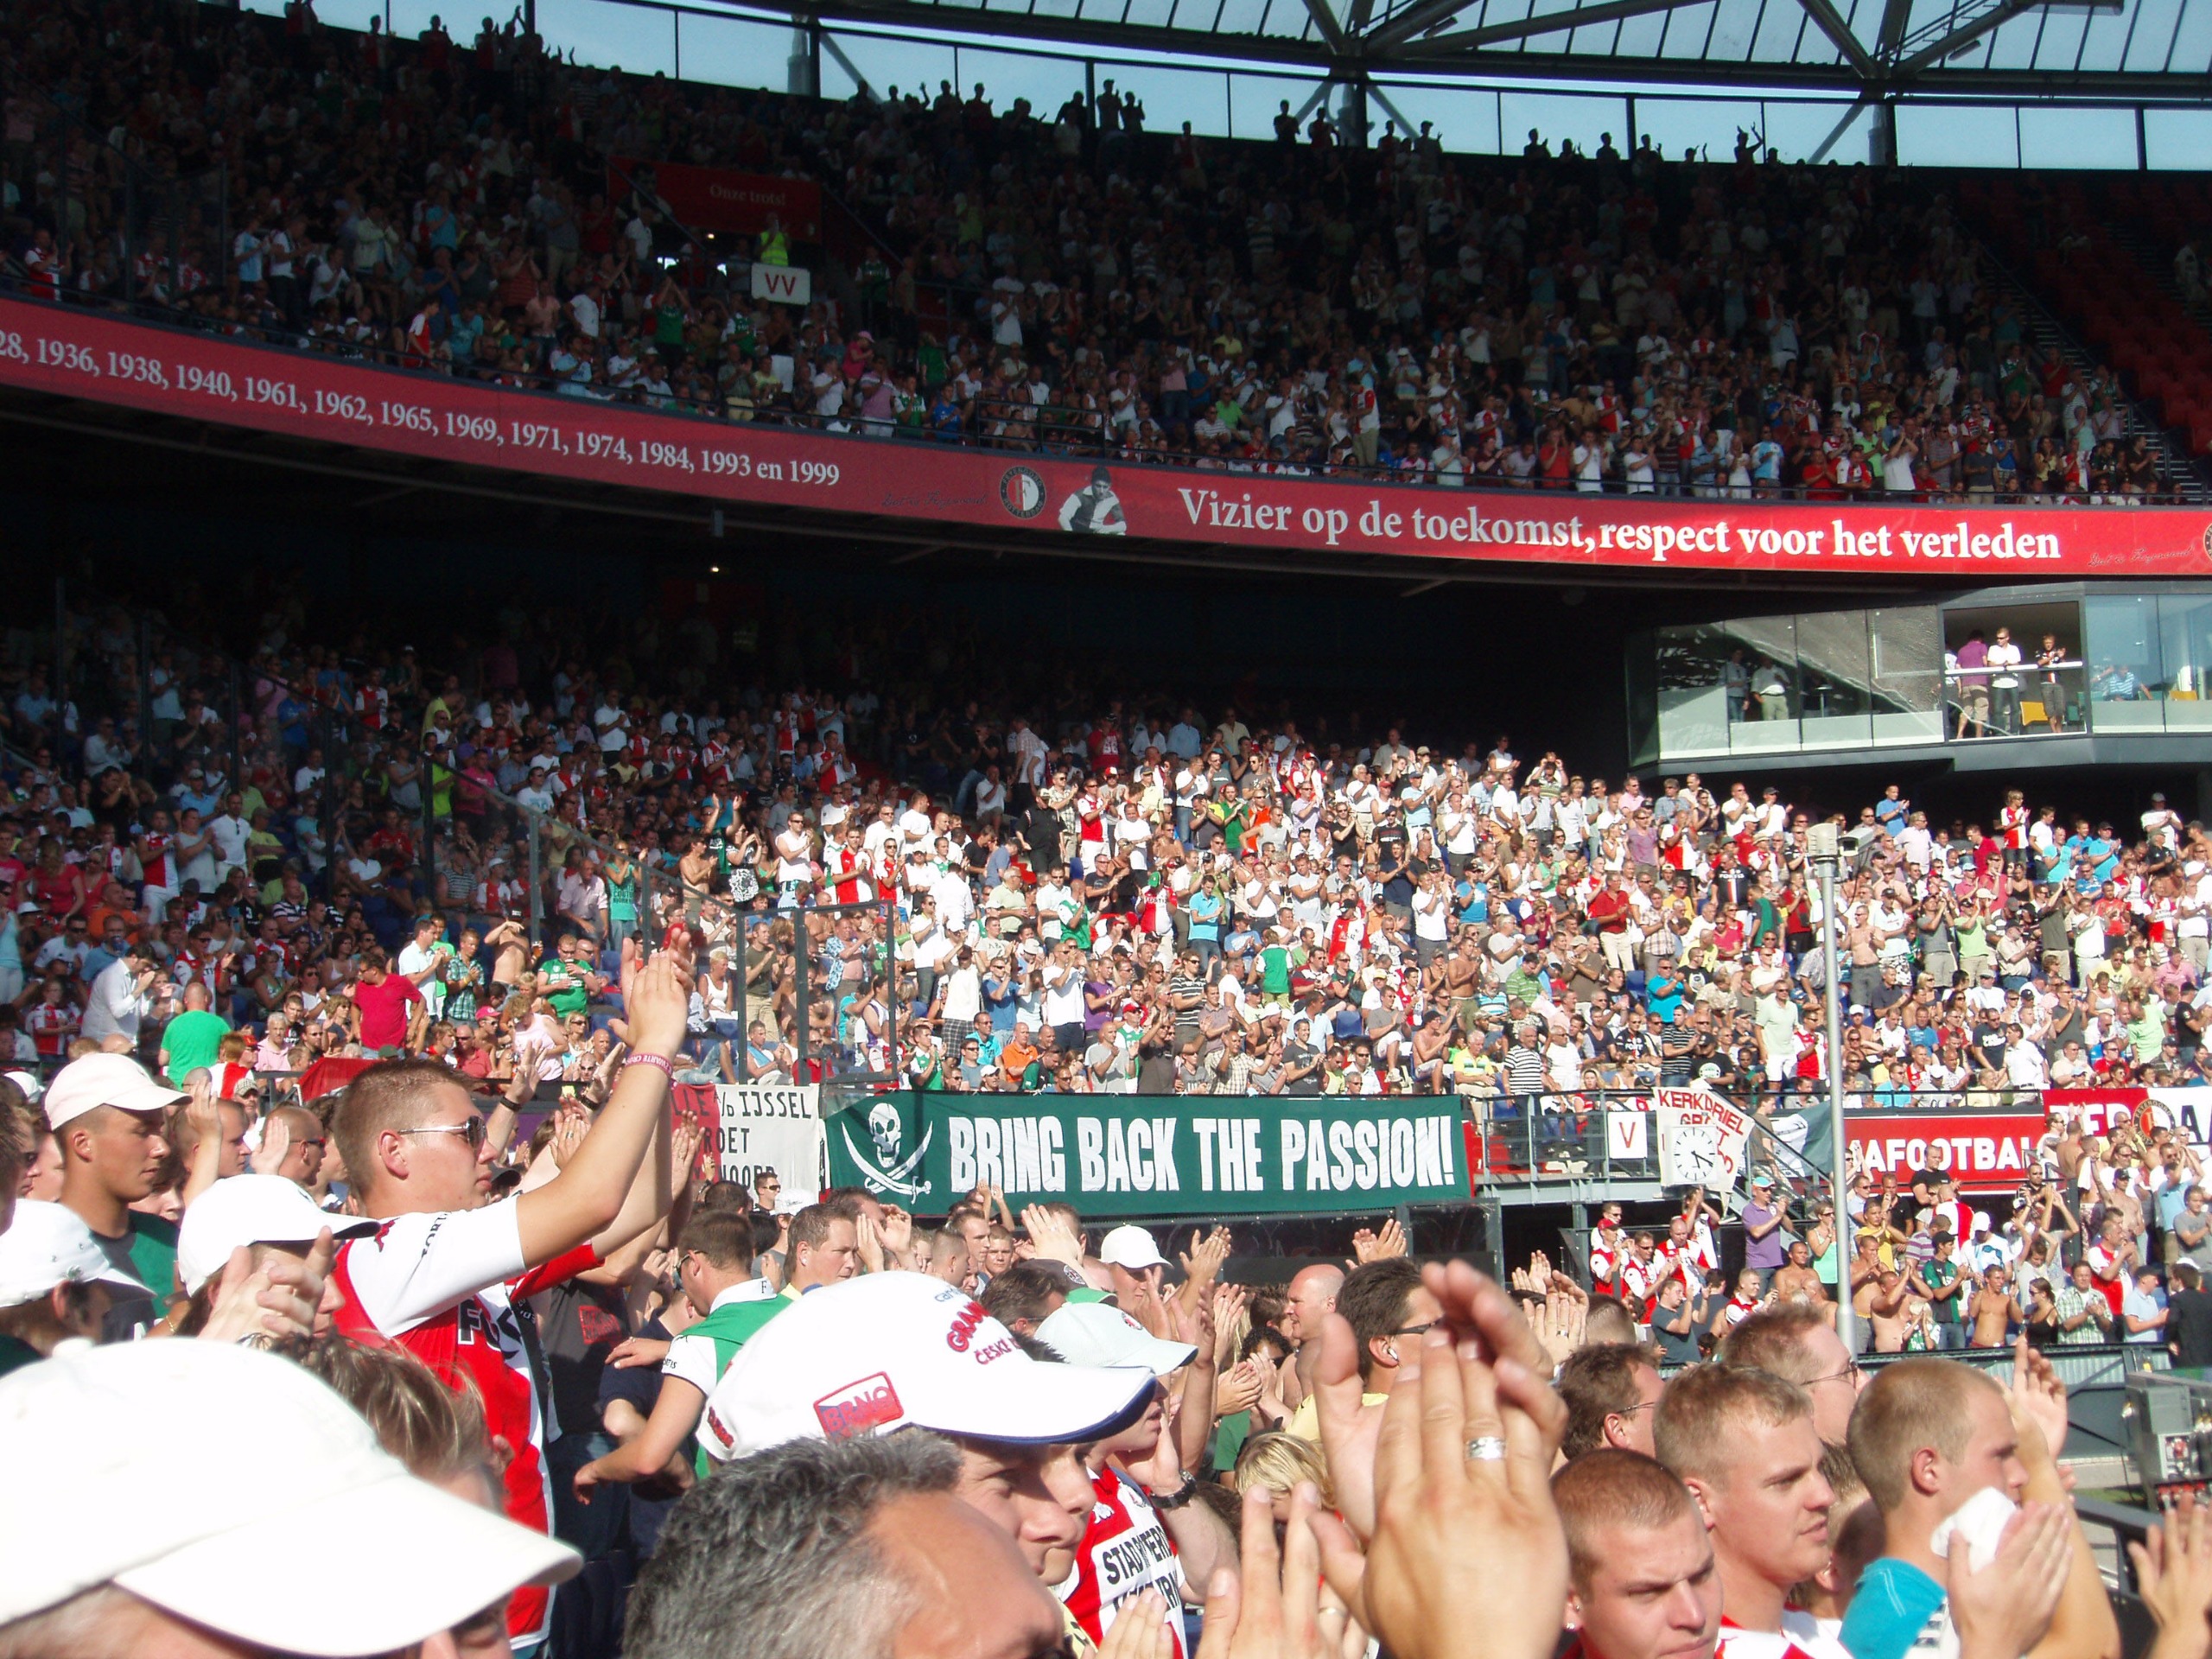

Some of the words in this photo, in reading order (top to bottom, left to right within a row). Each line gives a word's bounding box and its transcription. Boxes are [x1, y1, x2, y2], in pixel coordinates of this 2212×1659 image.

[766, 273, 796, 296] VV
[36, 338, 101, 378] 1936,
[107, 351, 170, 390] 1938,
[175, 364, 239, 403] 1940,
[245, 377, 308, 414] 1961,
[314, 390, 374, 425] 1962,
[380, 401, 440, 437] 1965,
[444, 412, 505, 447] 1969,
[511, 421, 569, 455] 1971,
[575, 430, 633, 465] 1974,
[639, 440, 696, 474] 1984,
[700, 449, 752, 478] 1993
[756, 461, 784, 481] en
[789, 460, 841, 486] 1999
[1178, 487, 1292, 531] Vizier
[1302, 502, 1349, 546] op
[1359, 500, 1402, 538] de
[1412, 505, 1595, 554] toekomst,
[1599, 521, 1731, 562] respect
[1737, 527, 1825, 556] voor
[1832, 519, 1892, 557] het
[1900, 522, 2062, 559] verleden
[739, 1090, 812, 1120] IJSSEL
[1657, 1089, 1744, 1135] KERKDRIEL
[703, 1126, 750, 1154] ROET
[1618, 1121, 1637, 1148] V
[949, 1116, 1065, 1193] BRING
[1077, 1116, 1180, 1192] BACK
[1193, 1117, 1263, 1192] THE
[1281, 1116, 1456, 1191] PASSION!
